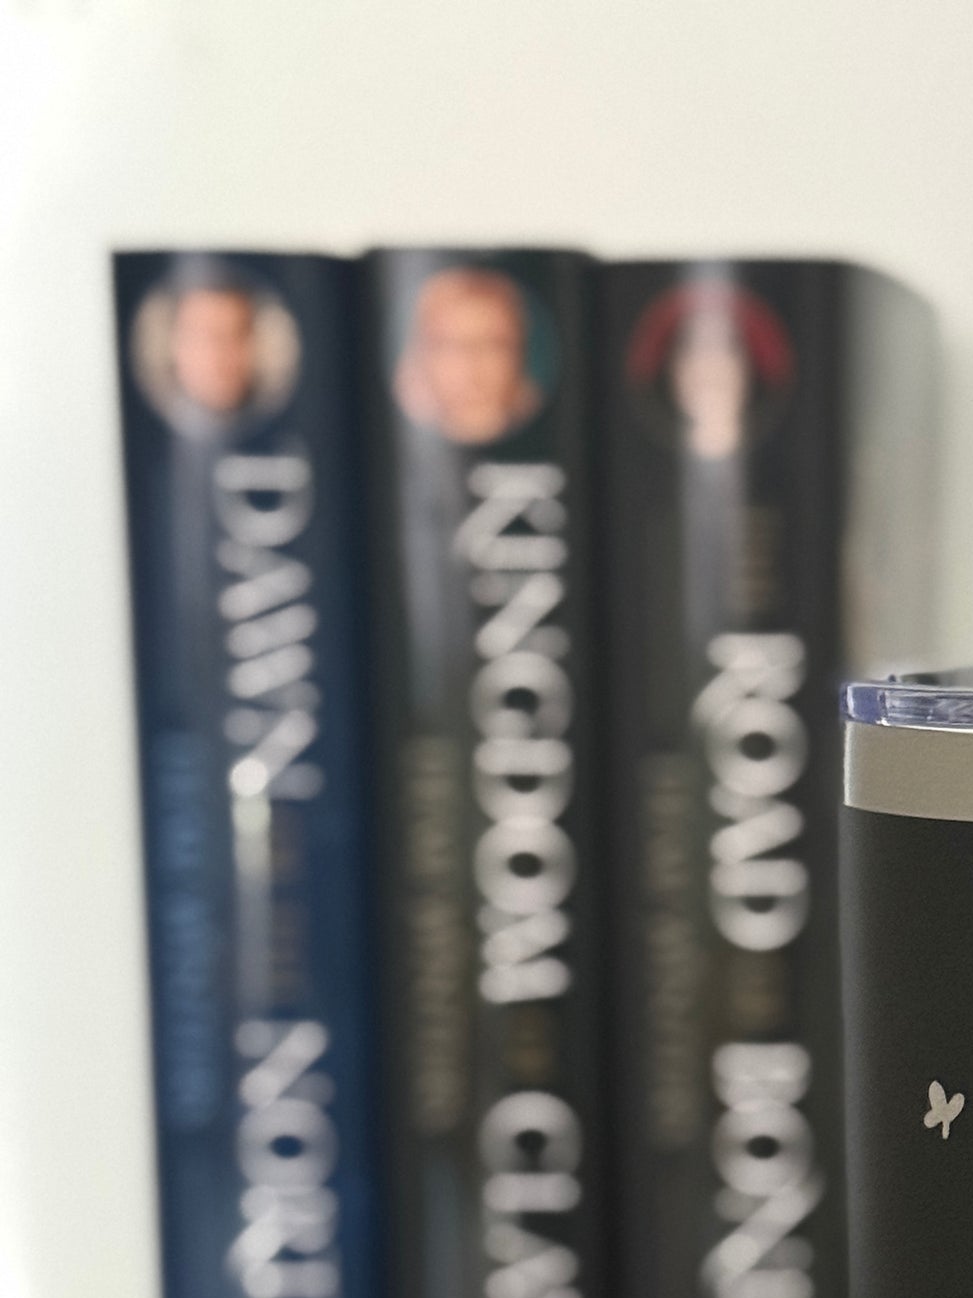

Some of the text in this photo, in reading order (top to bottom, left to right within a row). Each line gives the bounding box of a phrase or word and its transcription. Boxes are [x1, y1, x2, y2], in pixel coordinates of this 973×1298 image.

[214, 455, 324, 800] DAWN
[453, 463, 577, 1005] KINGDOM
[692, 632, 812, 950] ROAD
